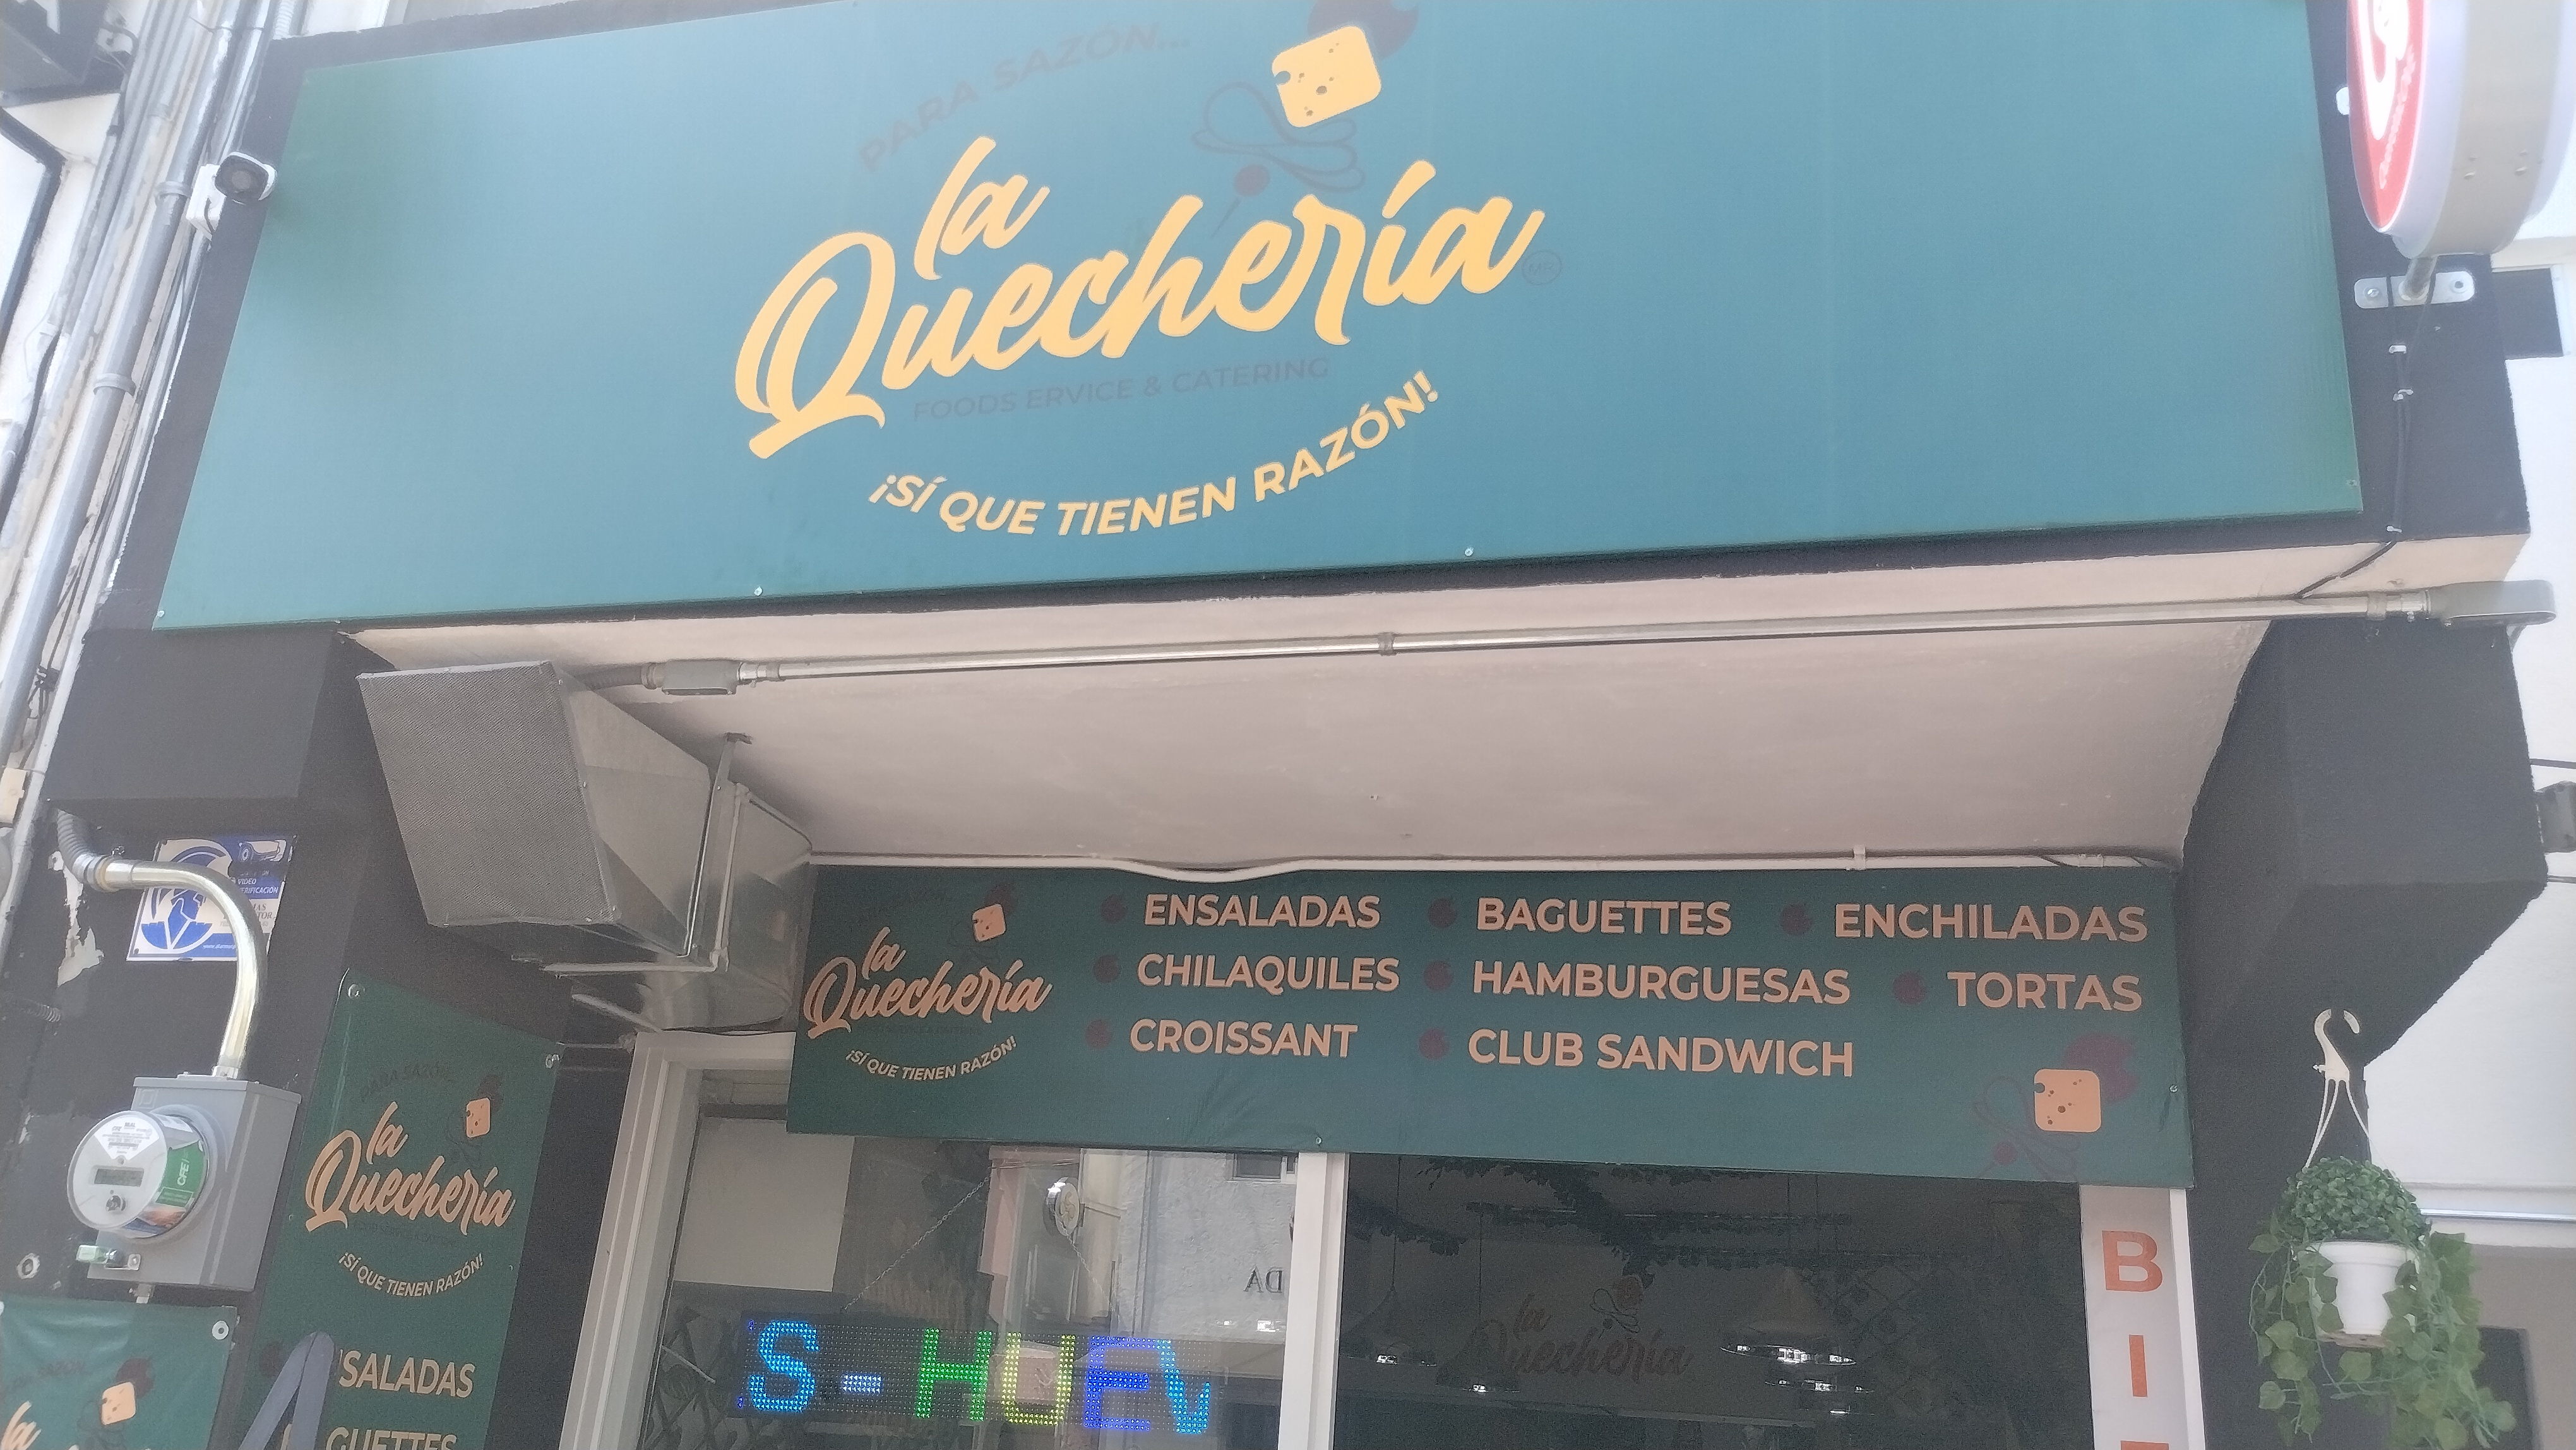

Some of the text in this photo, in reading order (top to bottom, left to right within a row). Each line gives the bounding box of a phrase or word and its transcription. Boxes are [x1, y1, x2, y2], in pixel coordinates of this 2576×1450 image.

[859, 80, 979, 173] PARA
[914, 136, 1049, 280] la
[735, 160, 1544, 458] Quechería
[1143, 375, 1162, 398] &
[1172, 356, 1330, 394] CATERING
[939, 491, 1045, 534] QUE
[1058, 477, 1236, 536] TIENEN
[1254, 371, 1438, 501] RAZÓN!
[1144, 894, 1380, 929] ENSALADAS
[1477, 897, 1732, 936] BAGUETTES
[1835, 903, 2147, 942] ENCHILADAS
[861, 926, 907, 981] la
[1137, 953, 1400, 996] CHILAQUILES
[803, 959, 1053, 1040] Quechería
[1474, 961, 1851, 1005] HAMBURGUESAS
[1948, 971, 2142, 1012] TORTAS
[867, 1059, 900, 1078] QUE
[902, 1064, 957, 1081] TIENEN
[960, 1035, 1017, 1075] RAZÓN!
[1130, 1018, 1358, 1058] CROISSANT
[1468, 1028, 1854, 1077] CLUB SANDWICH
[366, 1101, 408, 1165] la
[305, 1129, 516, 1236] Quechería
[357, 1265, 386, 1290] QUE
[386, 1279, 434, 1297] TIENEN
[436, 1252, 484, 1293] RAZÓN!
[338, 1350, 475, 1398] SALADAS
[325, 1426, 457, 1450] GUETTES
